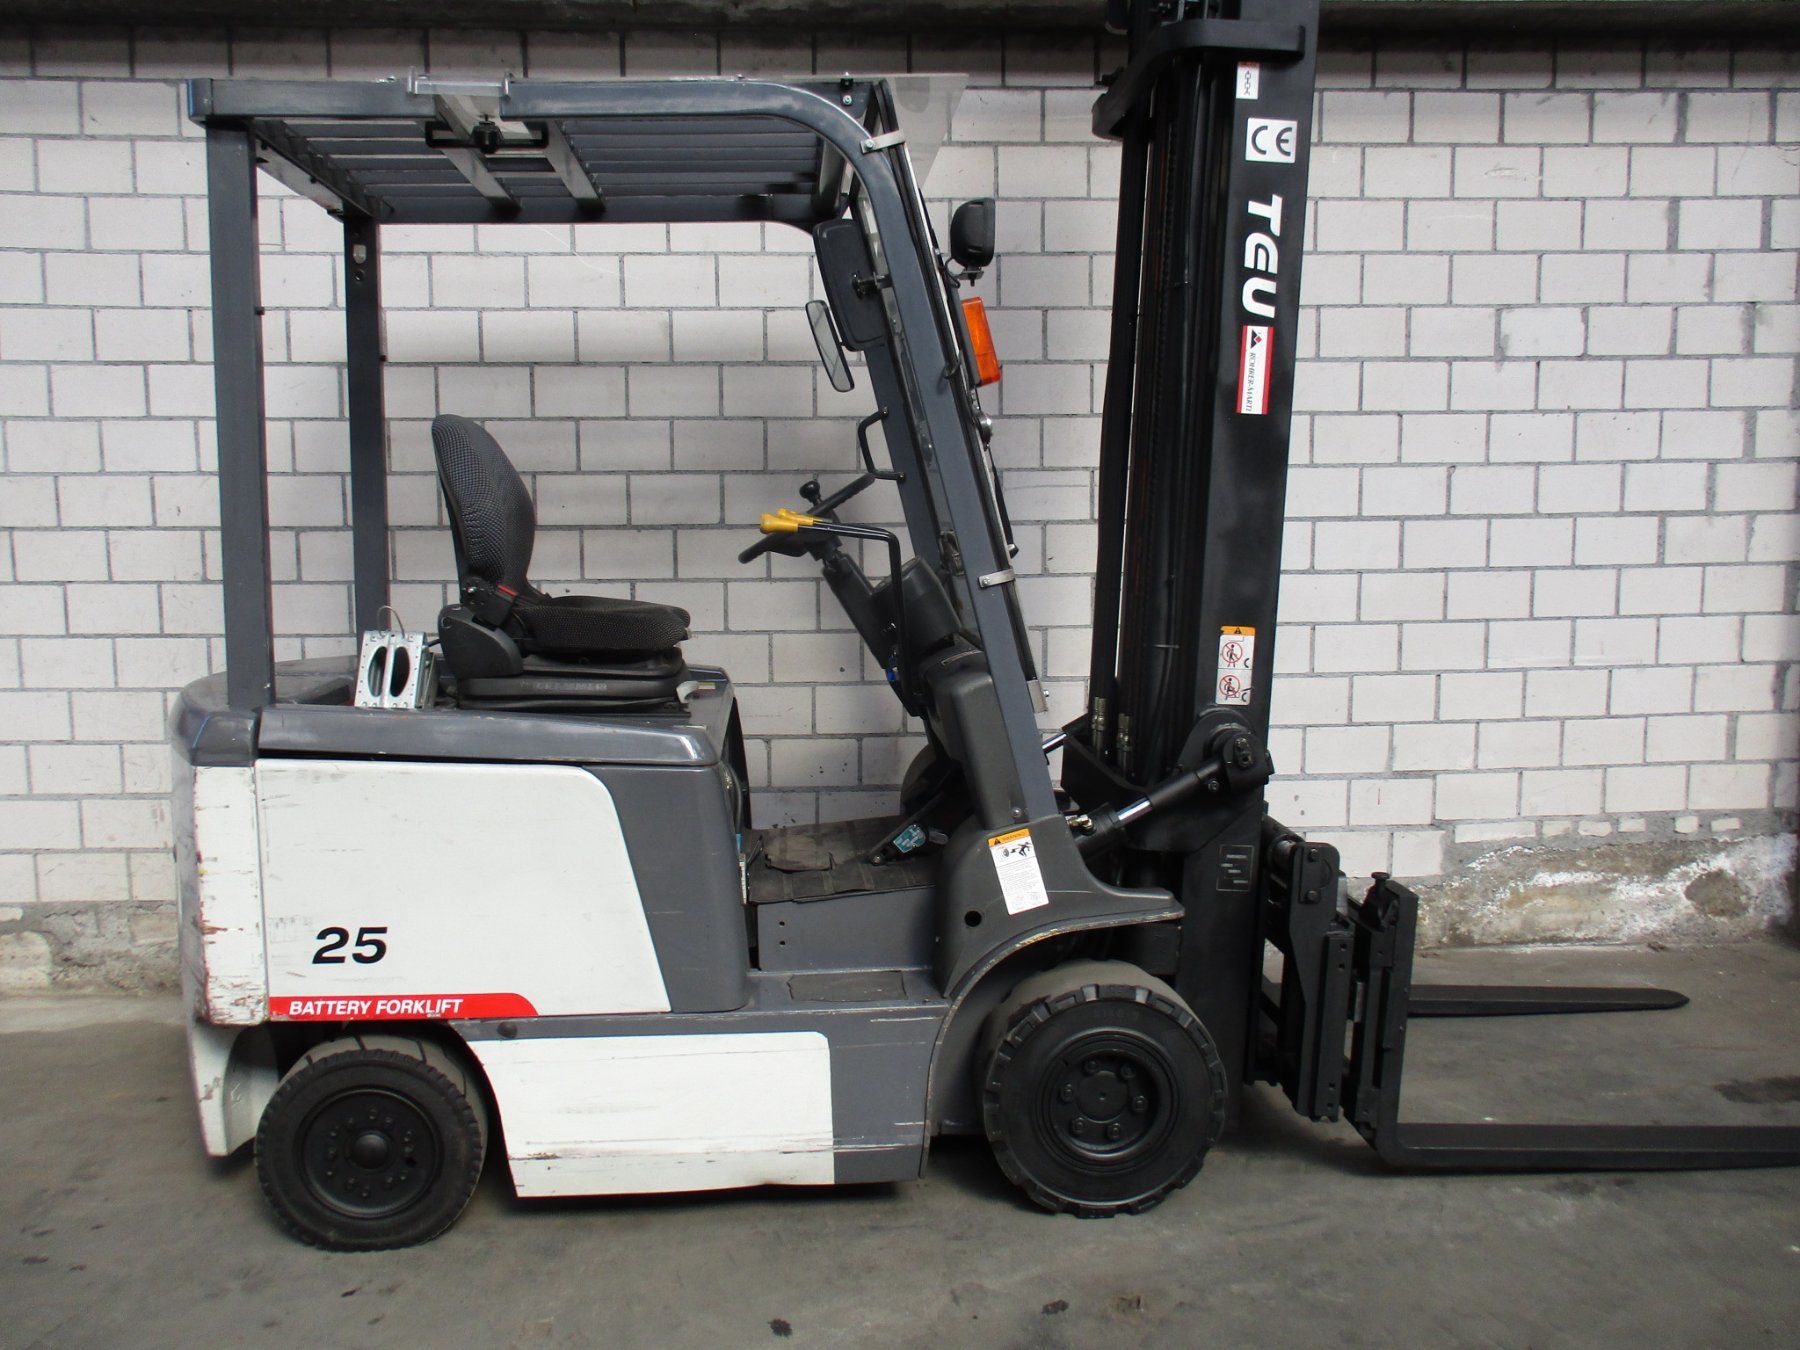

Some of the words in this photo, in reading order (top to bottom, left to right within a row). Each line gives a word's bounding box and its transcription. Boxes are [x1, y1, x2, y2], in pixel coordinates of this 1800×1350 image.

[1251, 125, 1293, 157] CE
[1241, 193, 1283, 319] TEU
[312, 926, 388, 965] 25
[289, 1000, 372, 1016] BATTERY
[375, 998, 463, 1016] FORKLIFT
